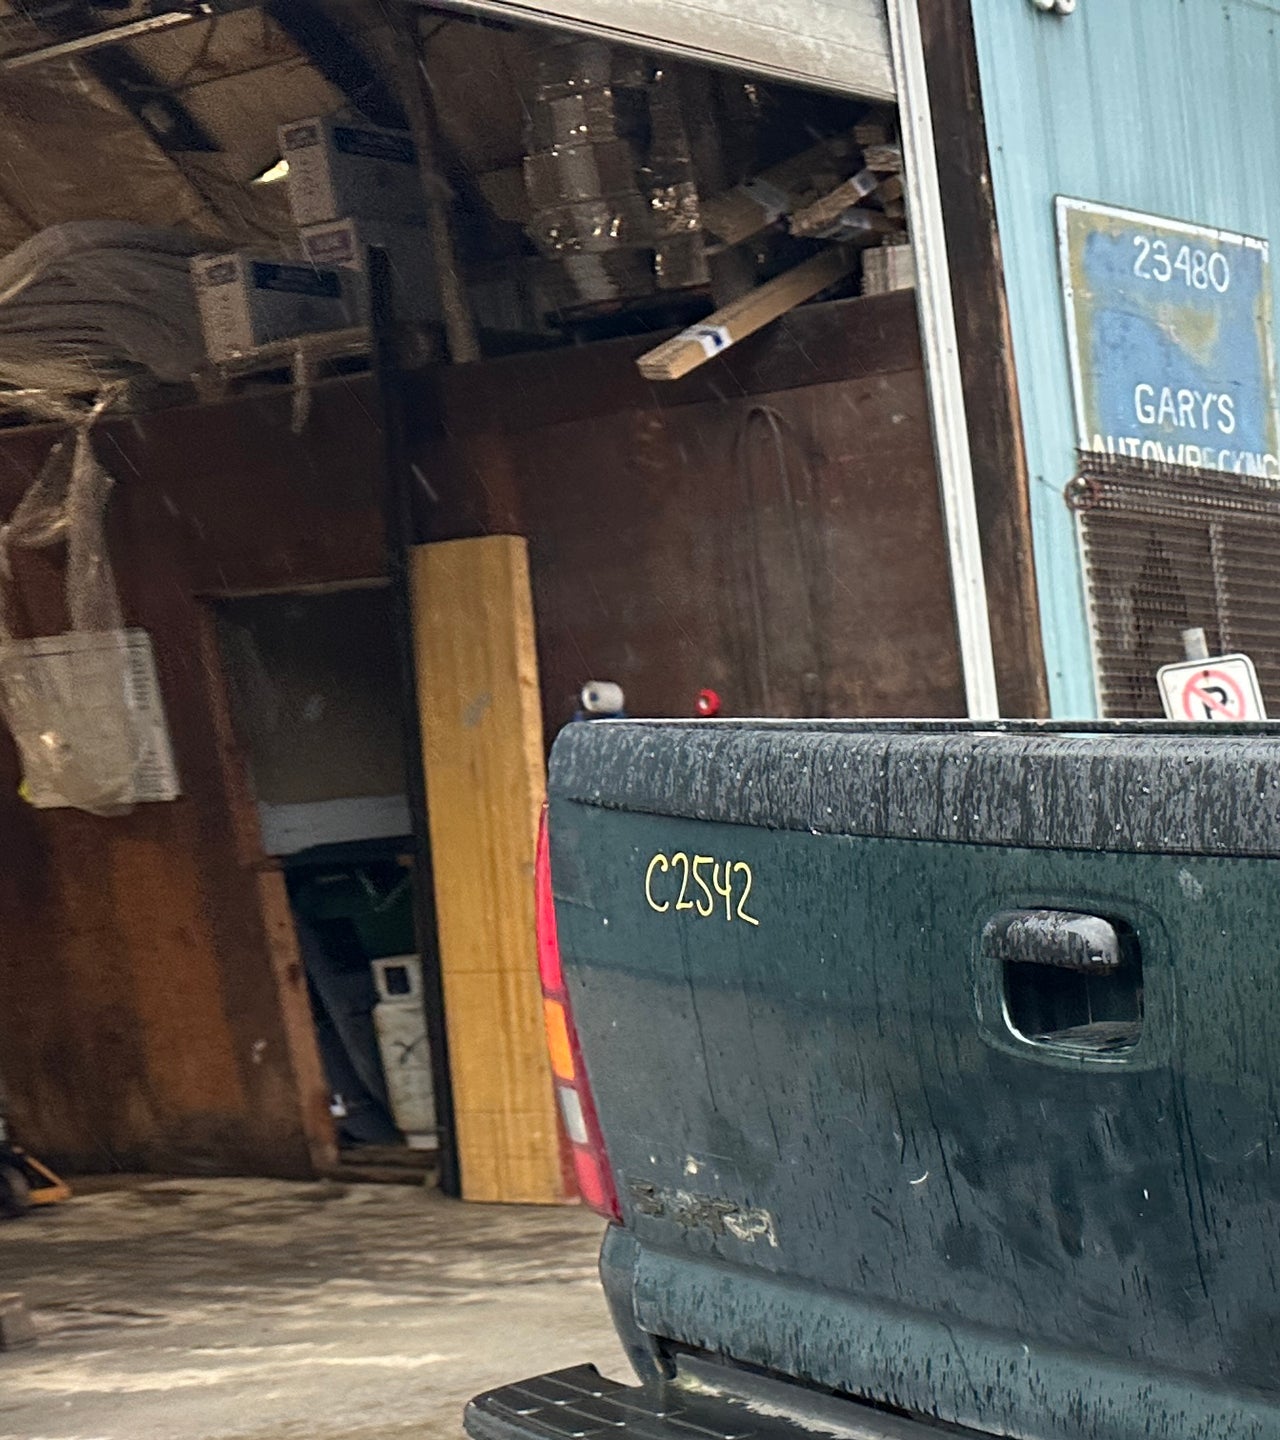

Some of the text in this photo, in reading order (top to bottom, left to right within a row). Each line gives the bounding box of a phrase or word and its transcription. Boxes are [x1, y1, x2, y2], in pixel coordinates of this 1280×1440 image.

[1133, 236, 1230, 293] 23480
[1134, 383, 1236, 434] GARY'S
[645, 851, 759, 926] C2542
